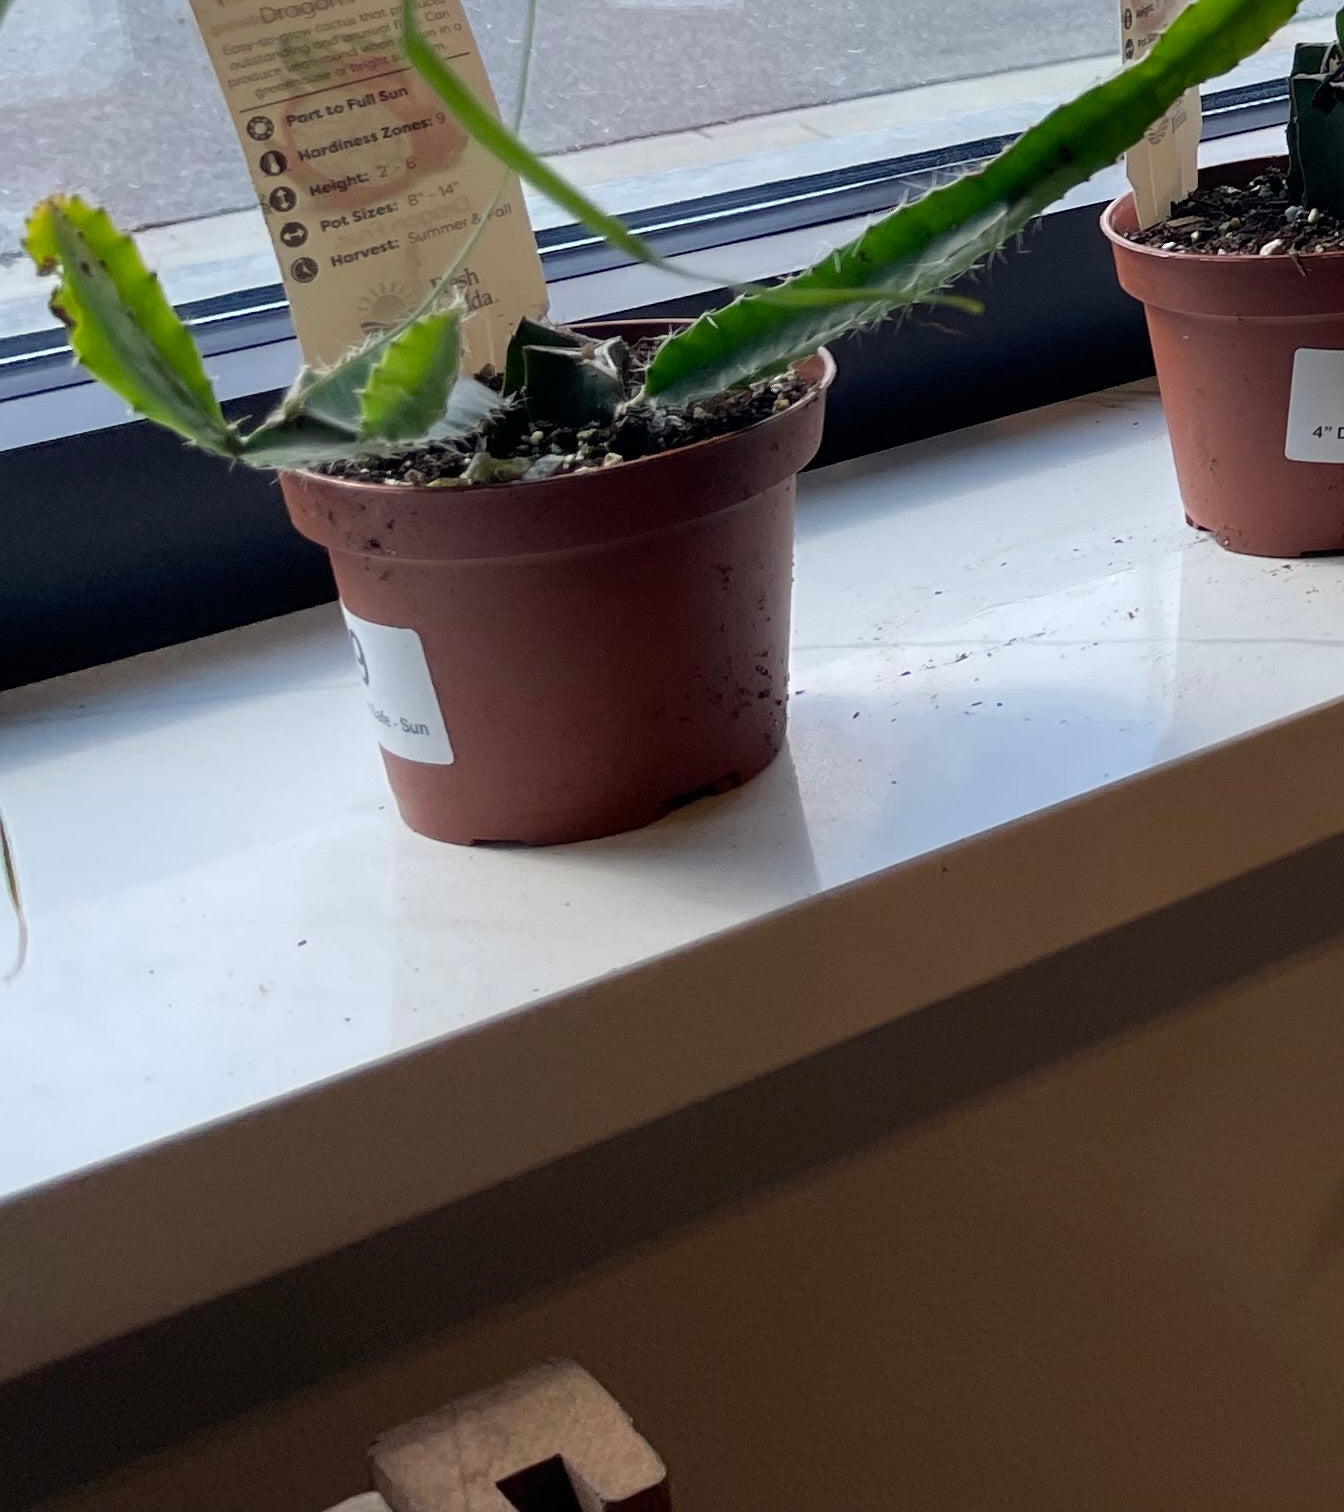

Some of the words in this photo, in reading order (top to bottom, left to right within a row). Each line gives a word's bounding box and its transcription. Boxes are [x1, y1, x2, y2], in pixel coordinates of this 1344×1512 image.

[223, 29, 312, 55] Easy-to-grow
[313, 35, 340, 49] and
[425, 11, 451, 22] Can
[228, 68, 282, 89] produce
[286, 108, 324, 128] Part
[326, 102, 344, 117] to
[347, 93, 376, 111] Full
[379, 87, 409, 102] Sun
[298, 131, 379, 162] Hardiness
[381, 117, 434, 139] Zones:
[436, 112, 447, 125] 9
[309, 171, 370, 198] Height:
[320, 212, 350, 232] Pot
[353, 201, 399, 223] Sizes:
[330, 239, 400, 267] Harvest:
[408, 218, 468, 244] Summer
[472, 212, 482, 225] &
[400, 717, 430, 736] Sun
